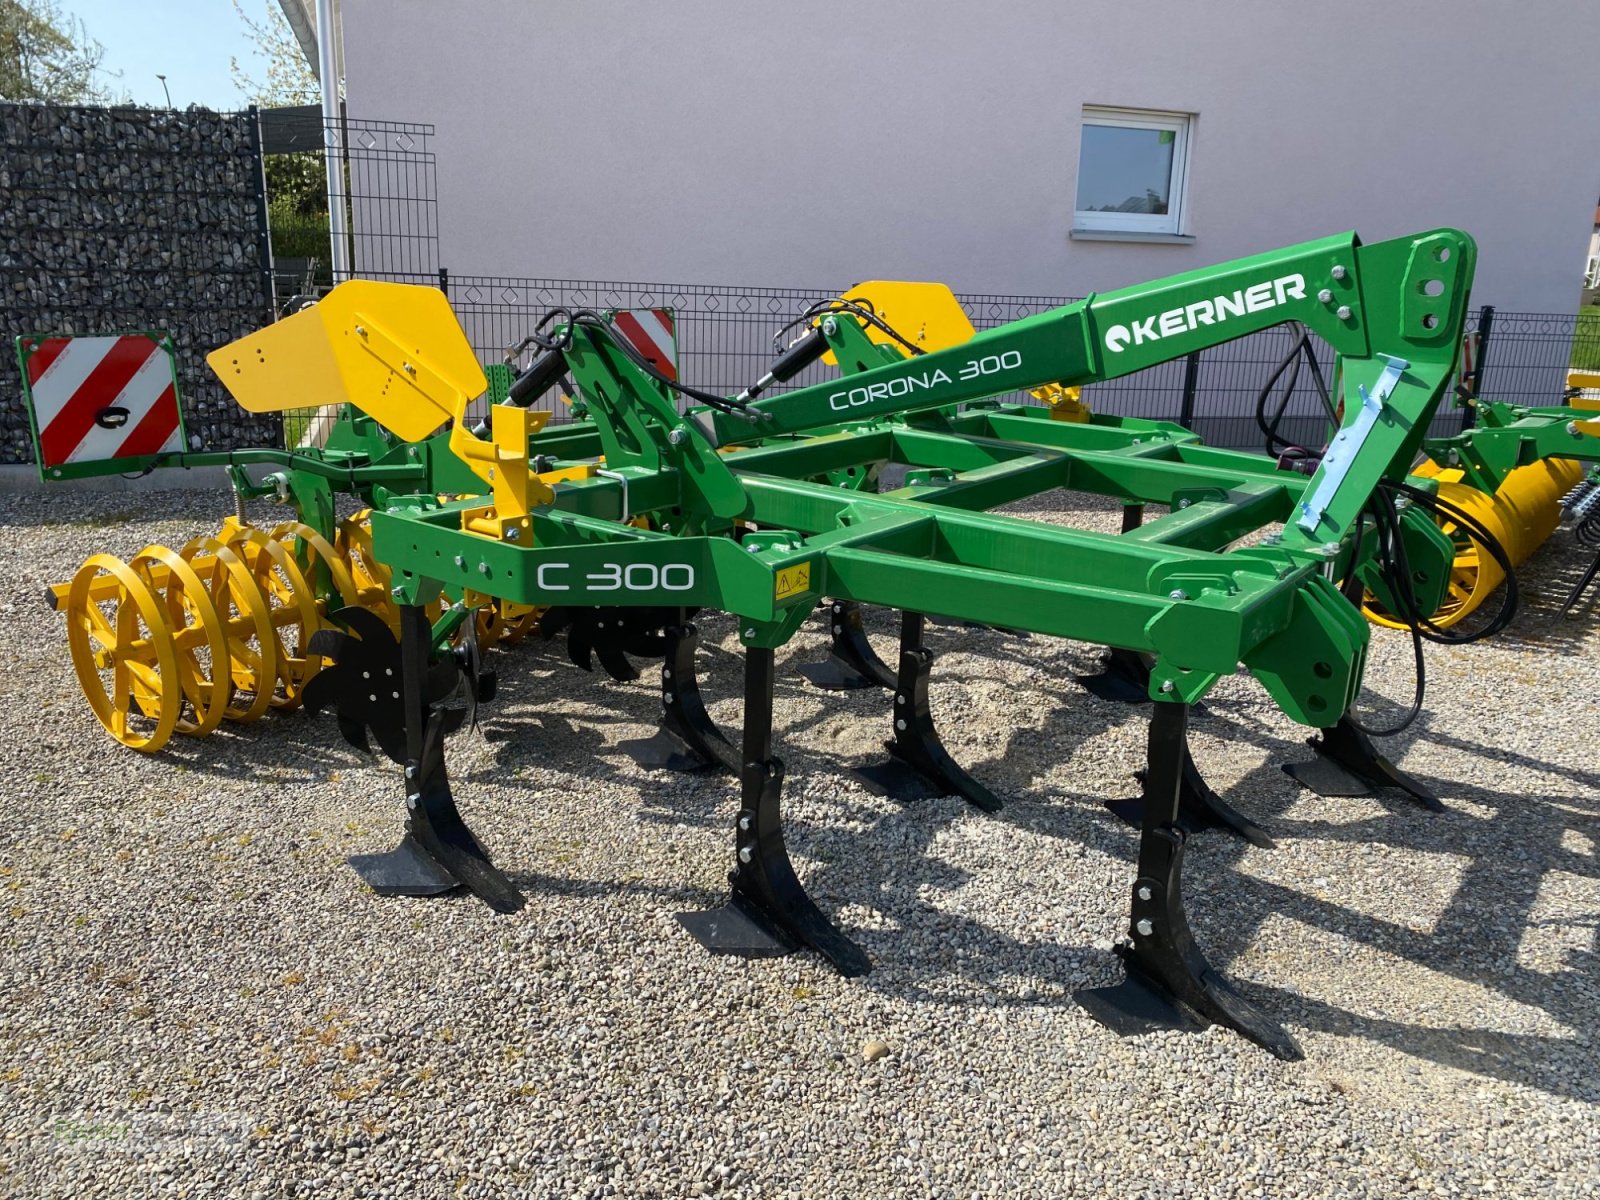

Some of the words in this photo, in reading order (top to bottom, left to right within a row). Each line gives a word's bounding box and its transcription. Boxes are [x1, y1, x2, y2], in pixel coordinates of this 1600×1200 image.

[1131, 273, 1308, 346] KERNER
[829, 368, 953, 411] CORONA
[958, 350, 1022, 381] 300
[537, 563, 570, 591] C
[586, 563, 695, 591] 300
